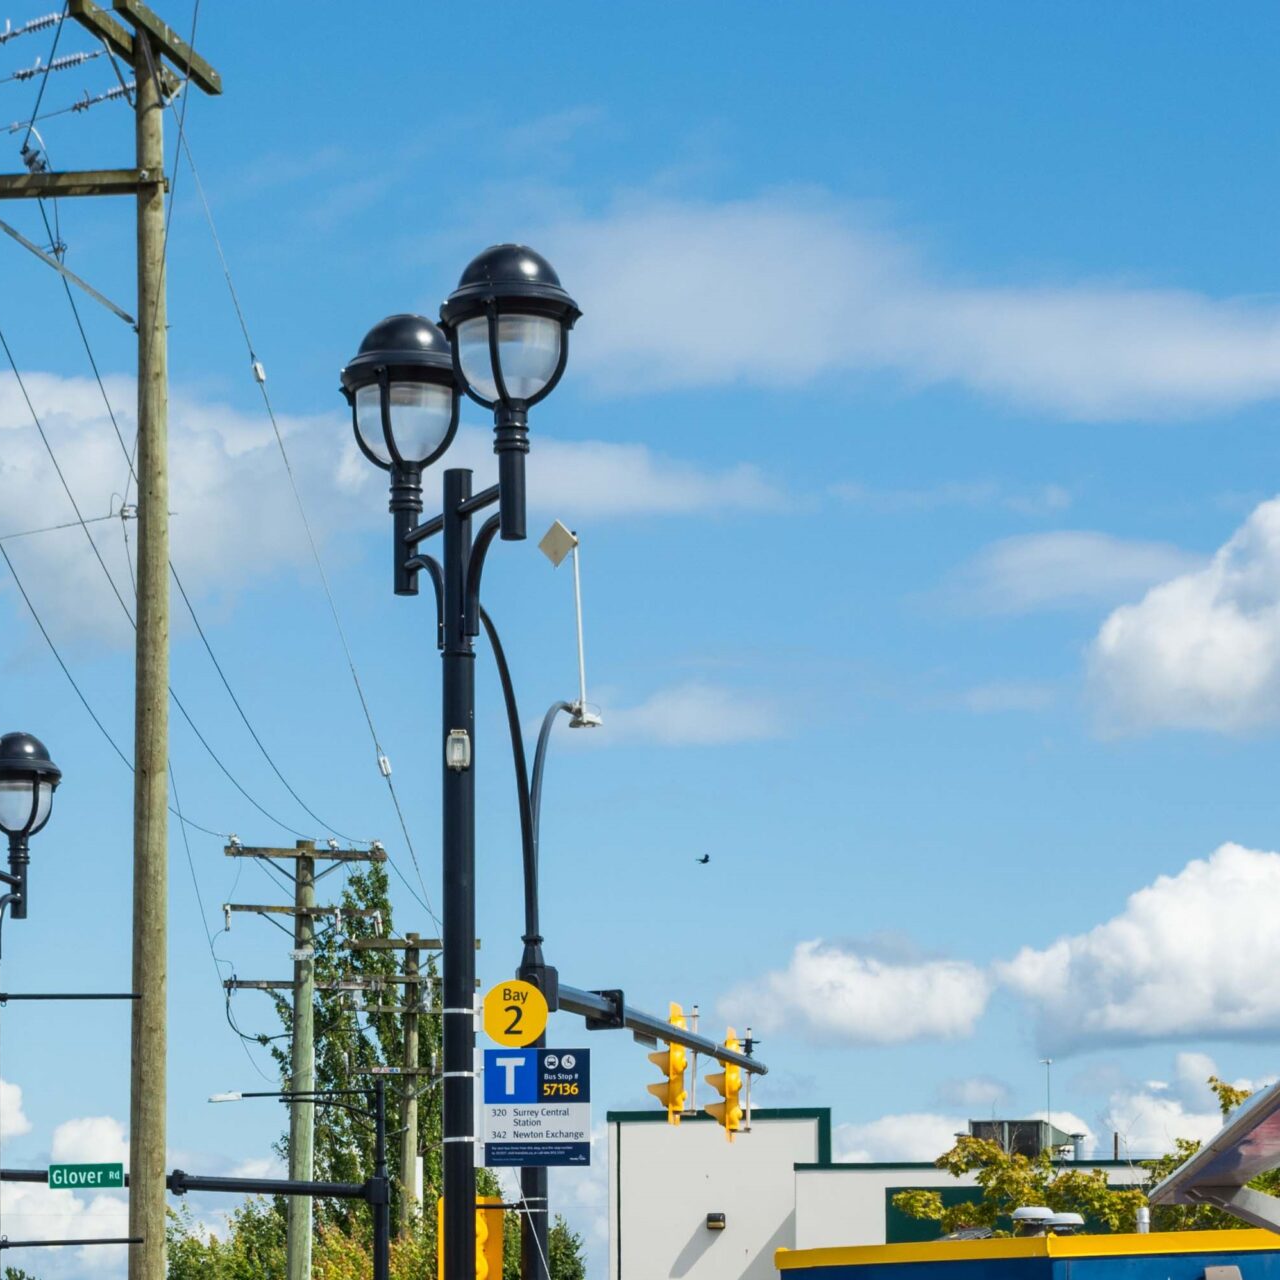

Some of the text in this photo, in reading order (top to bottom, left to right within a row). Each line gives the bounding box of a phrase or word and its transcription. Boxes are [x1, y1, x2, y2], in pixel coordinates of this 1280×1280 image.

[503, 988, 529, 1003] Bay
[504, 1005, 523, 1035] 2
[495, 1057, 526, 1095] T
[557, 1073, 573, 1081] Stop
[543, 1082, 579, 1096] 57136
[492, 1108, 569, 1118] 320 Surrey Central
[513, 1118, 542, 1127] Station
[492, 1130, 584, 1140] 342 Newton Exchange
[52, 1168, 120, 1185] Glover Rd
